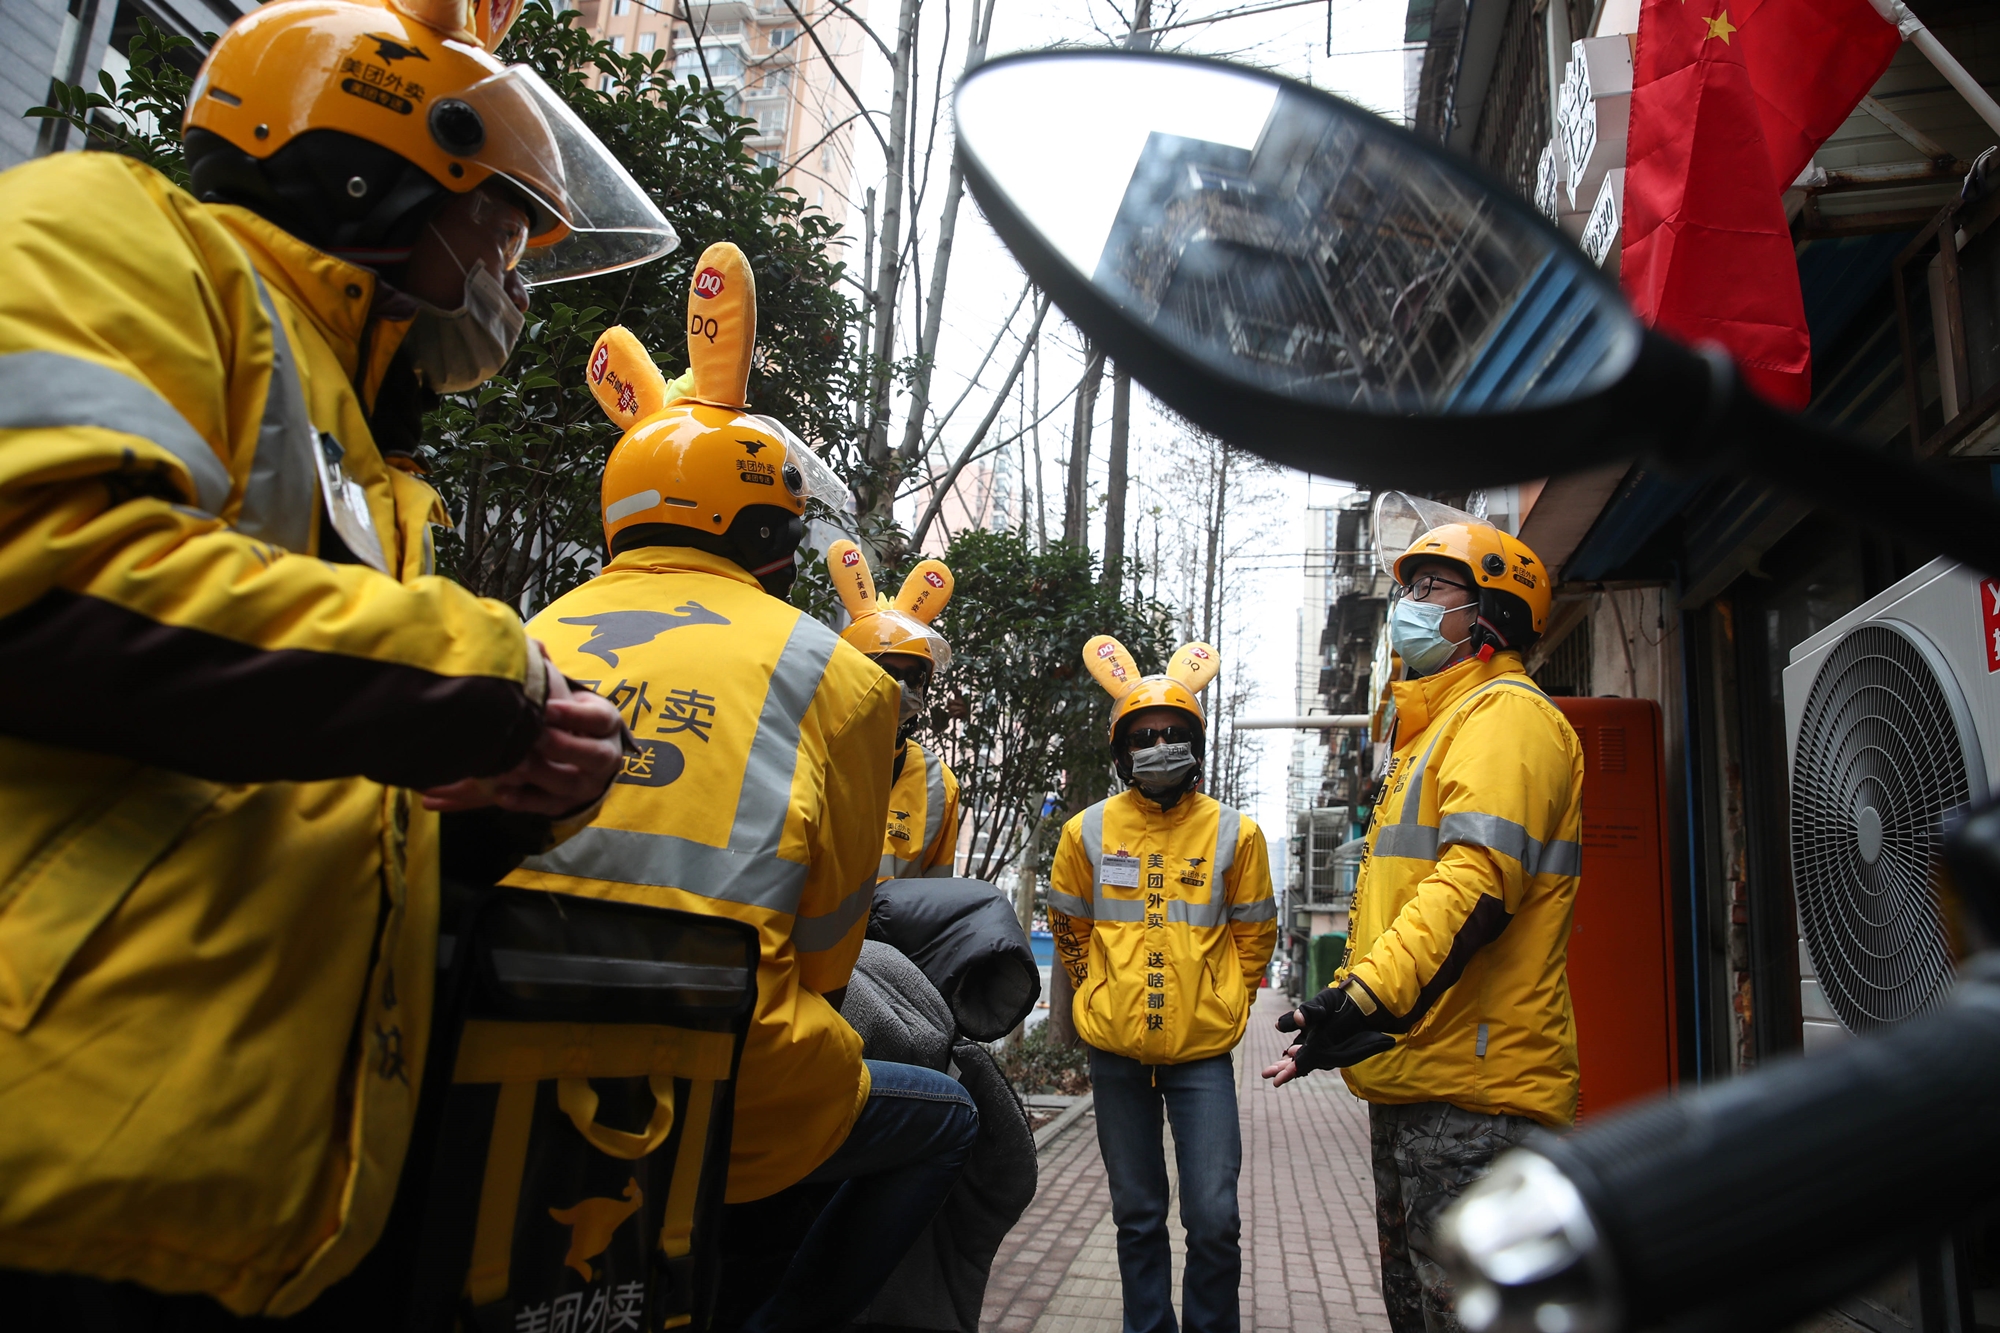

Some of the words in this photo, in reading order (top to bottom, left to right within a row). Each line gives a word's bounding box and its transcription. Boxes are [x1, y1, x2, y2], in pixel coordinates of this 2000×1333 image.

[340, 57, 425, 103] 美团外卖
[698, 273, 721, 295] DQ
[691, 314, 718, 344] DQ
[592, 347, 609, 379] DQ
[736, 459, 776, 475] 美团外卖
[844, 551, 859, 564] DQ
[855, 571, 868, 599] 上美团
[927, 572, 943, 588] DQ
[1512, 565, 1537, 583] 美团外卖
[911, 591, 930, 613] 点外卖
[1099, 644, 1114, 656] DQ
[1182, 658, 1200, 672] DQ
[573, 679, 716, 743] 外卖
[1180, 869, 1207, 879] 美团外卖
[1147, 854, 1164, 929] 美团外卖
[1147, 952, 1164, 1031] 送啥都快
[515, 1281, 644, 1333] 美团外卖
